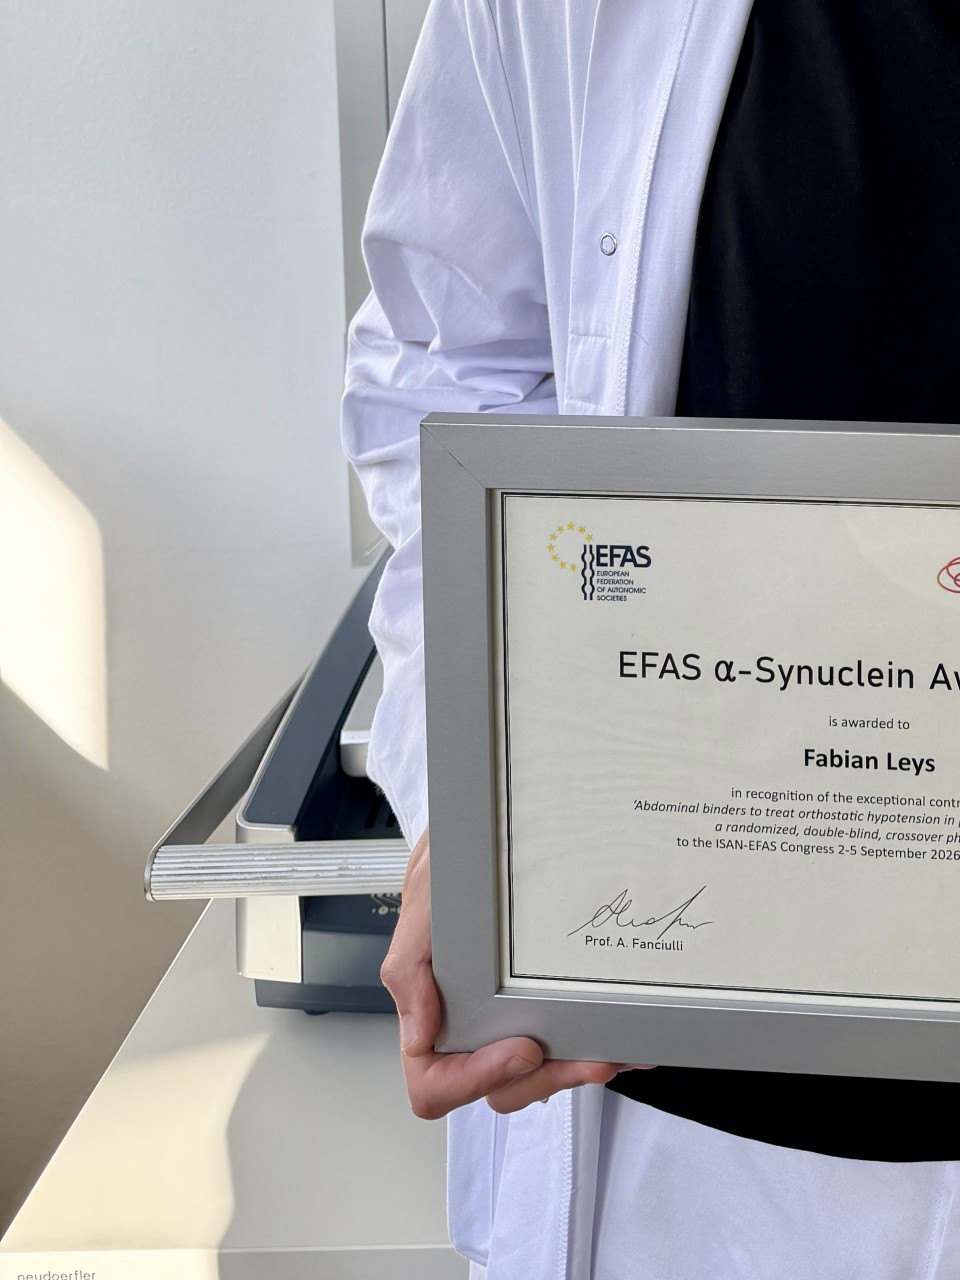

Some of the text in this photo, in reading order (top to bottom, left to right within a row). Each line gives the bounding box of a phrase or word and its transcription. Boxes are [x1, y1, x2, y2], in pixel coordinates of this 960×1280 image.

[596, 544, 652, 568] EFAS
[618, 651, 702, 681] EFAS
[714, 656, 915, 690] α-Synuclein
[828, 716, 910, 730] is awarded to
[803, 748, 936, 774] Fabian Leys
[731, 787, 742, 798] in
[746, 789, 814, 803] recognition
[817, 791, 830, 802] of
[832, 792, 853, 804] the
[856, 794, 926, 807] exceptional
[702, 804, 747, 816] binders
[749, 807, 762, 817] to
[765, 808, 795, 819] treat
[798, 809, 864, 822] orthostatic
[866, 811, 941, 825] hypotension
[944, 814, 955, 826] in
[715, 823, 723, 832] a
[725, 823, 800, 837] randomized,
[803, 825, 882, 841] double-blind,
[885, 831, 943, 843] crossover
[676, 837, 689, 847] to
[692, 837, 713, 848] the
[715, 838, 777, 851] ISAN-EFAS
[780, 841, 835, 855] Congress
[838, 844, 858, 856] 2-5
[860, 846, 927, 860] September
[930, 849, 960, 861] 2026
[585, 935, 684, 951] Prof. A. Fanciulli
[17, 1270, 96, 1280] neudoerfler
